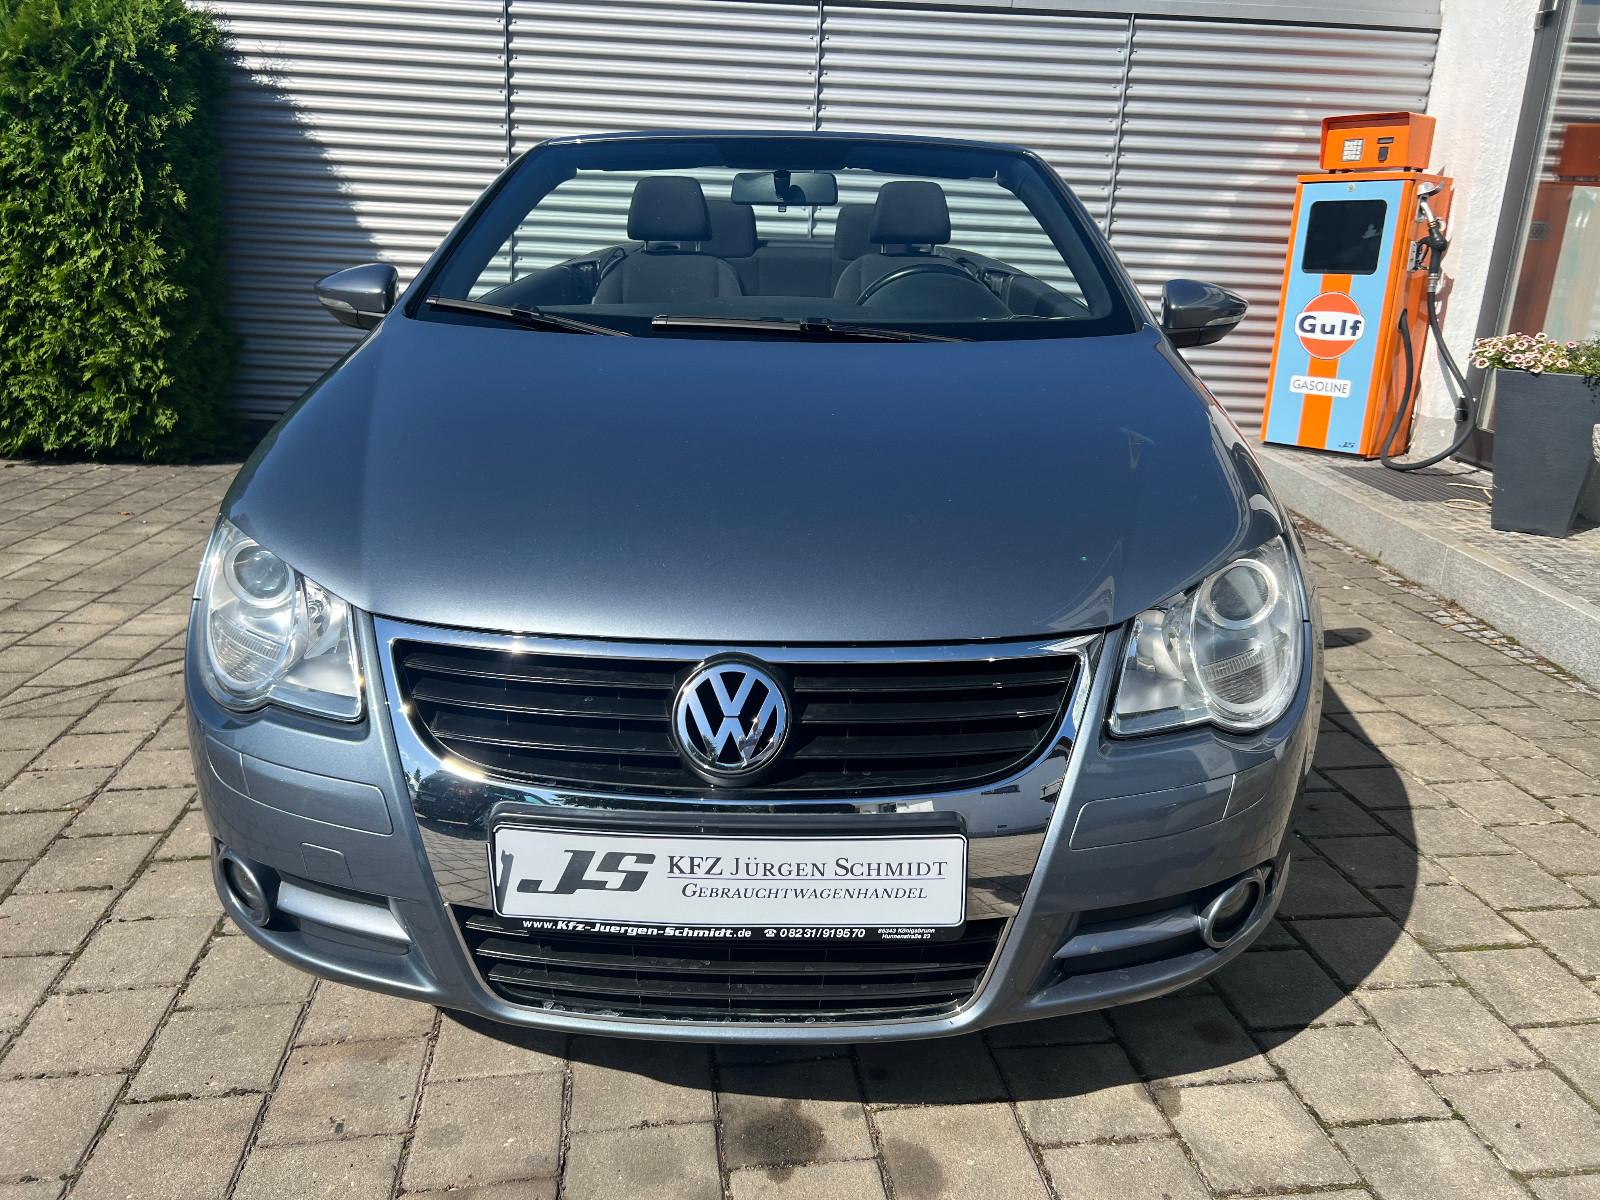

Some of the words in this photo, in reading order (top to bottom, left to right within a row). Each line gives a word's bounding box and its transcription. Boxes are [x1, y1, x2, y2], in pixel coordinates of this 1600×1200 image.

[1298, 315, 1362, 337] Gulf
[1292, 379, 1349, 394] GASOLINE
[516, 849, 656, 895] JS
[667, 855, 723, 876] KFZ
[729, 856, 826, 878] JÜRGEN
[834, 857, 948, 877] SCHMIDT
[682, 882, 928, 900] GEBRAUCHTWAGENHANDEL
[522, 920, 751, 938] www.Kfz-Juergen-Schmidt.de
